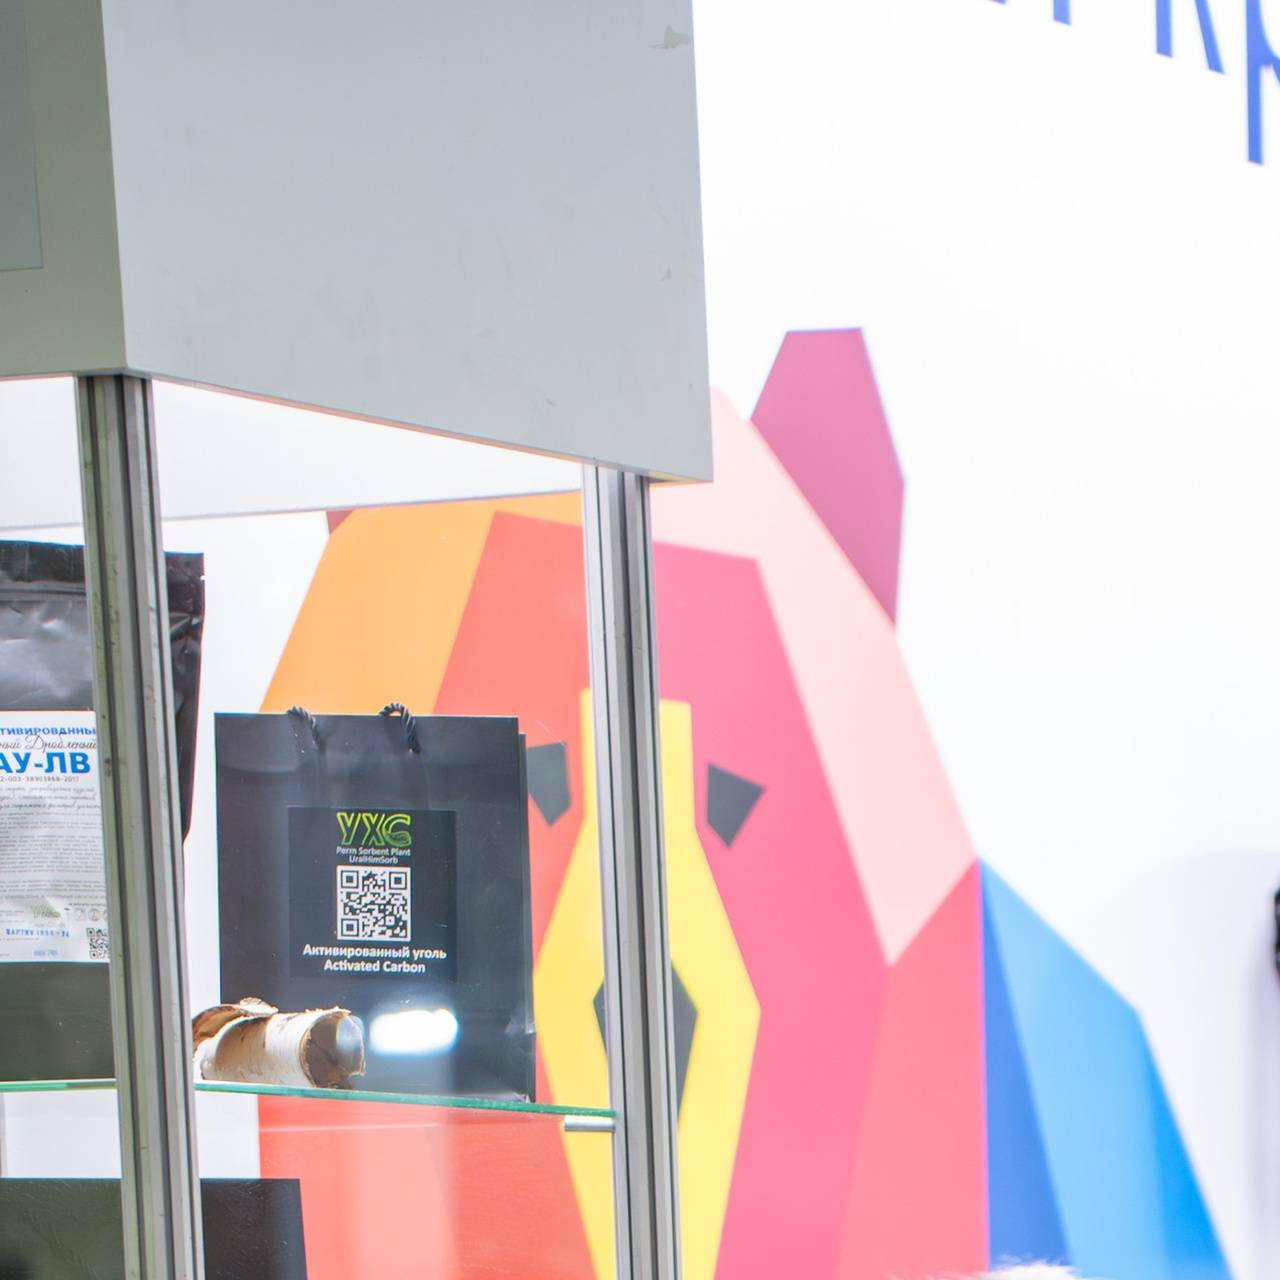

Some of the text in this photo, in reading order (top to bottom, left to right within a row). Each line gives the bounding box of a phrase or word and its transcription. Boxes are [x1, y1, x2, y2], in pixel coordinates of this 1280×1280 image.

[336, 846, 411, 856] Perm Sorbent Plant
[349, 855, 398, 864] UralHimSorb
[303, 944, 447, 960] Активированный уголь
[324, 959, 426, 973] Activated Carbon
